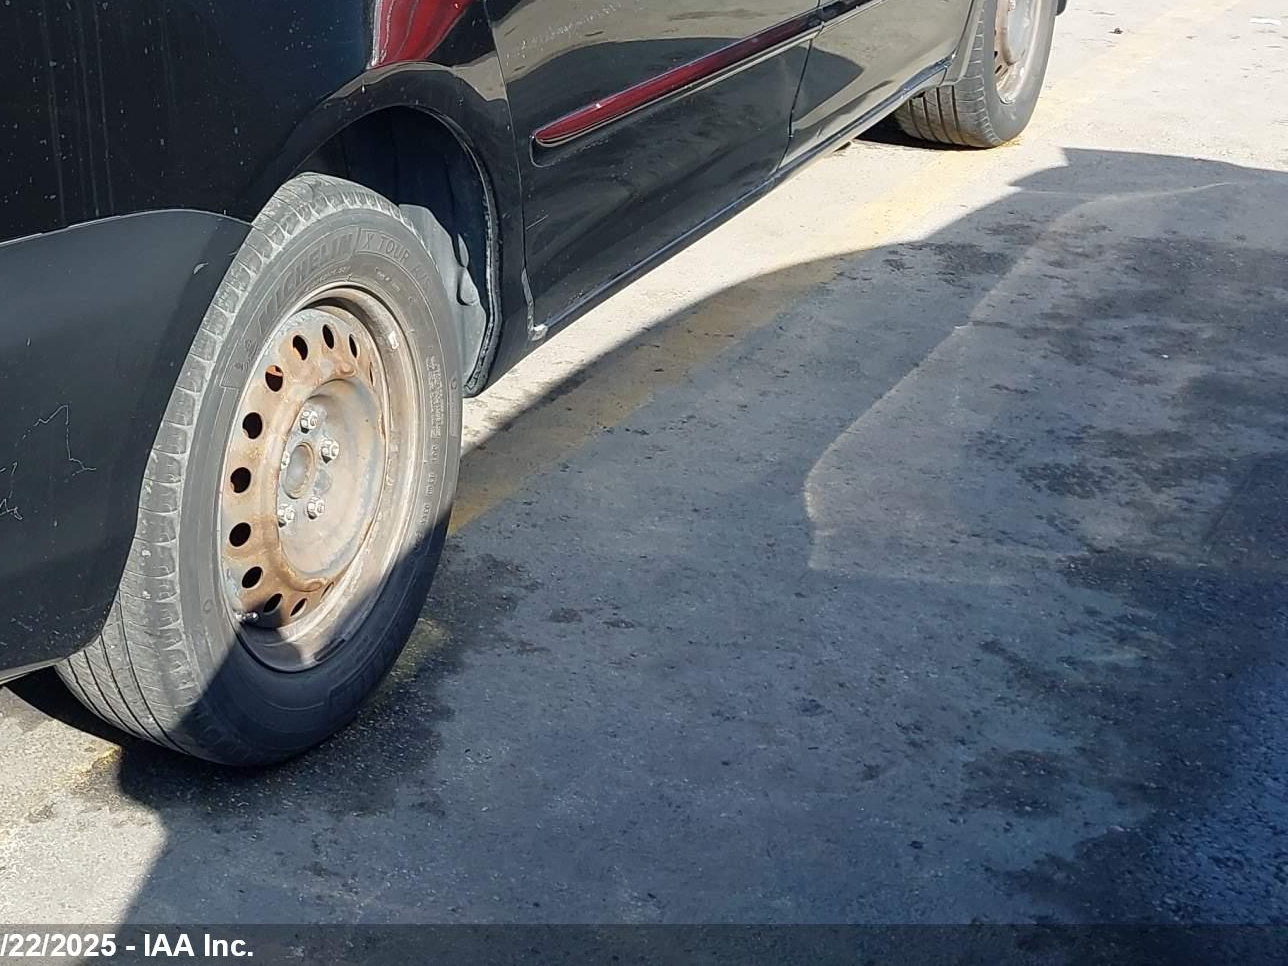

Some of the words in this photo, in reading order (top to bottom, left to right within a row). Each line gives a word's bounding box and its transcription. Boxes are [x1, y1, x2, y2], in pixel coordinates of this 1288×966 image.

[264, 230, 357, 316] MICHELIN
[362, 231, 375, 250] X
[378, 236, 410, 265] TOUR
